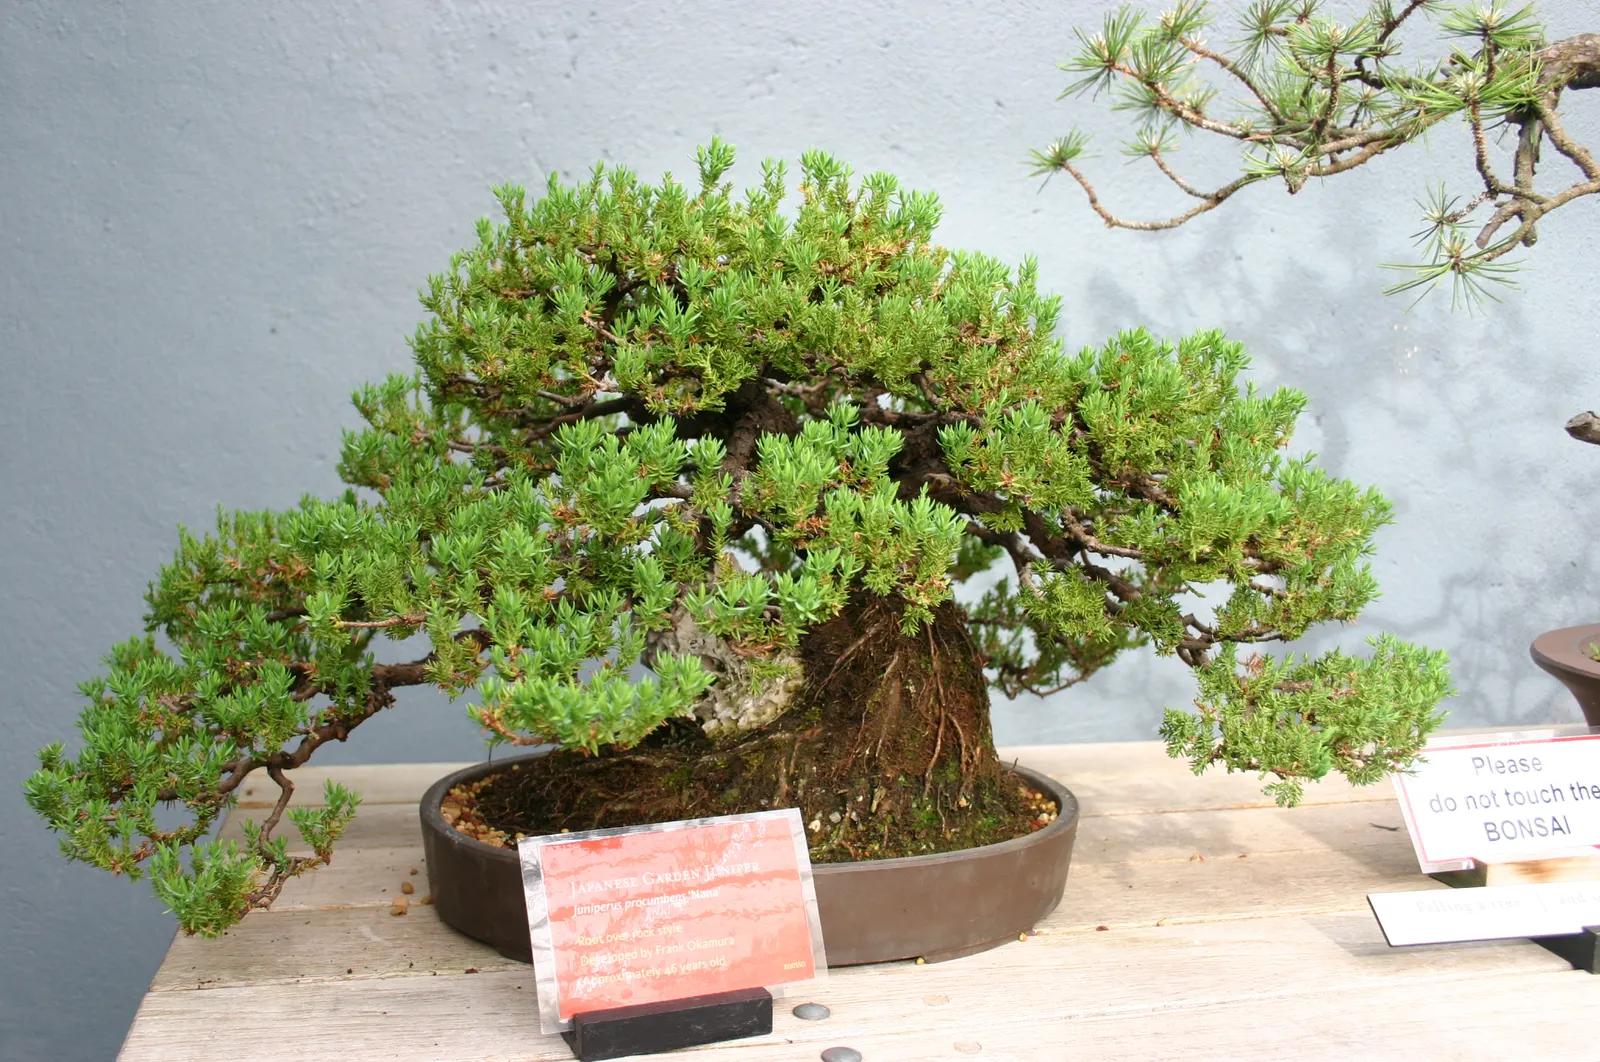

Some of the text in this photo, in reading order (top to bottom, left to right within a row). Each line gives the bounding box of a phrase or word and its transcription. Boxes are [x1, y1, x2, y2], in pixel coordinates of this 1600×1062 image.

[1471, 756, 1543, 776] Please
[1429, 781, 1600, 813] do not touch the
[1483, 815, 1572, 842] BONSAI
[569, 861, 760, 899] JAPANESE GARDEN JUNIPER
[573, 901, 622, 918] Juniperus
[624, 893, 687, 912] procumbens
[578, 923, 683, 947] Root over rock style
[580, 936, 735, 967] Developed by Frank Okamura
[664, 963, 678, 976] 46
[679, 961, 707, 974] years
[709, 956, 726, 967] old
